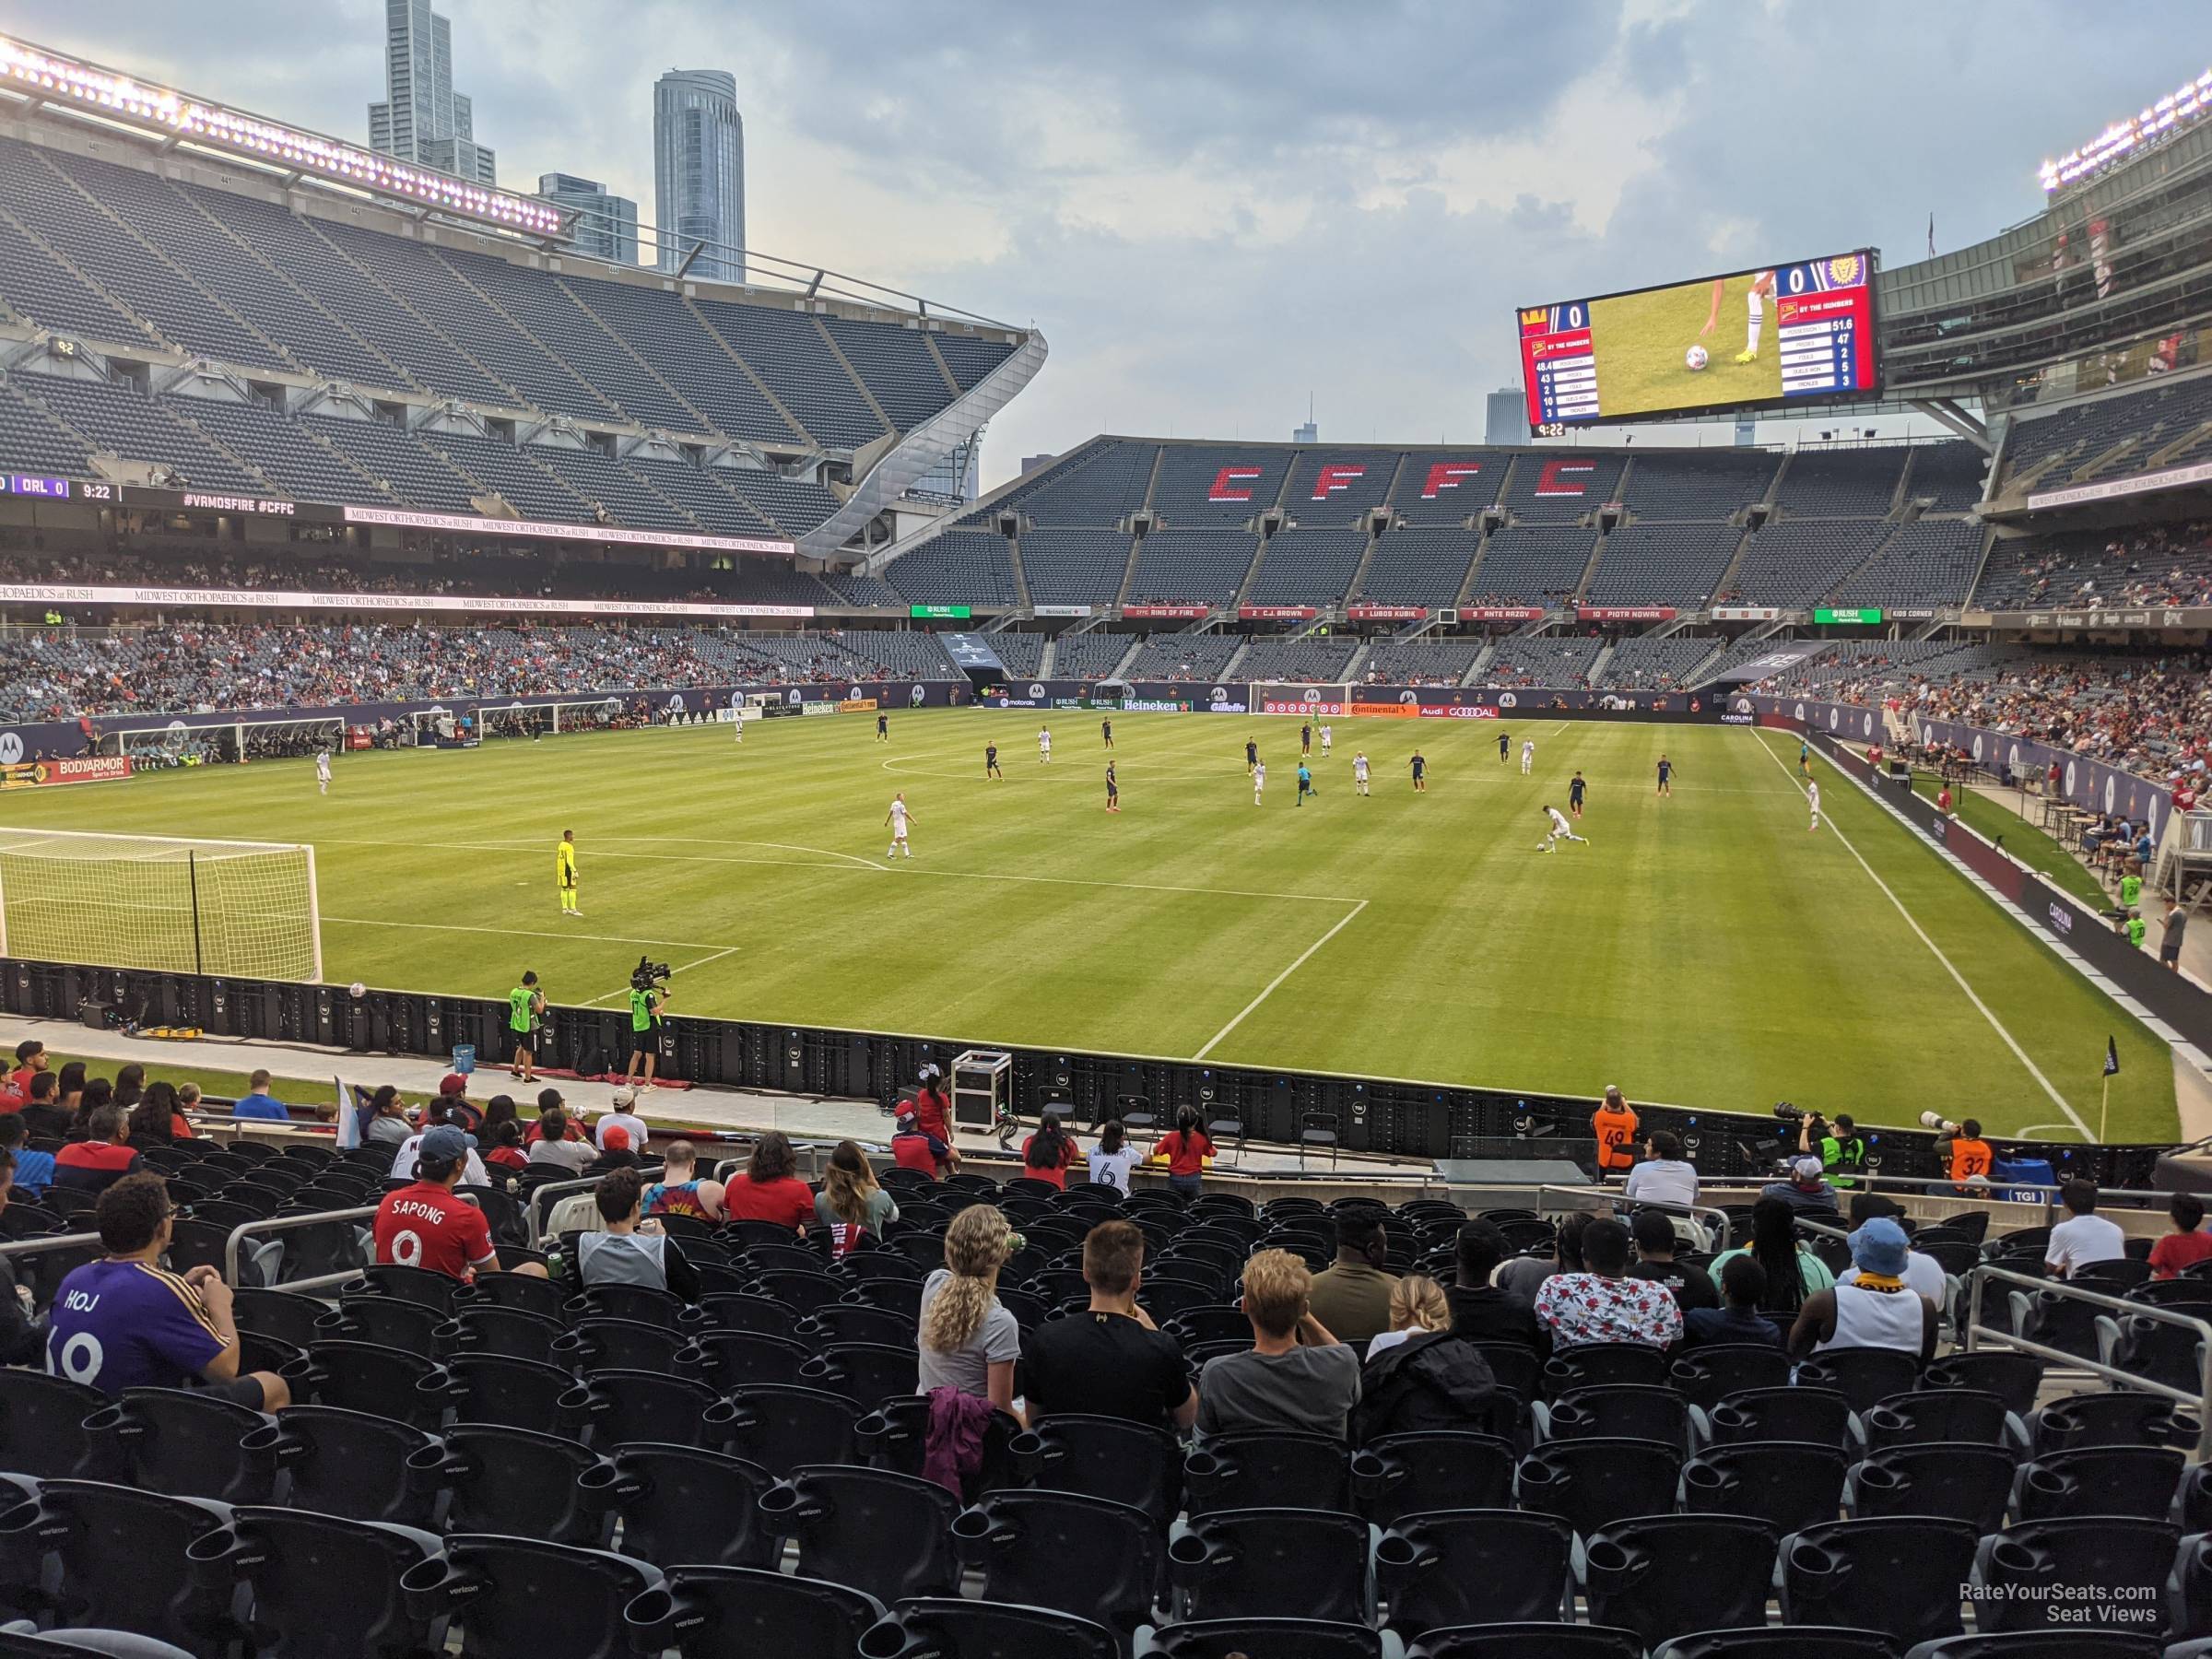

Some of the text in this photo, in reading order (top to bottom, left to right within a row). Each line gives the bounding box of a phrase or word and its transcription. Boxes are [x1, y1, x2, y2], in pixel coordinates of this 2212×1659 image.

[1790, 269, 1804, 293] 0
[1823, 299, 1853, 310] NUMBERS
[1570, 306, 1582, 328] 0
[1832, 318, 1853, 332] 51.6
[1566, 338, 1590, 347] NUMBERS
[1837, 333, 1849, 345] 47
[1841, 348, 1848, 359] 2
[1536, 361, 1552, 372] 48.4
[1841, 362, 1849, 372] 5
[1540, 374, 1550, 383] 43
[1842, 376, 1849, 386] 3
[1545, 386, 1550, 394] 2
[1544, 397, 1553, 406] 10
[1547, 409, 1552, 418] 3
[23, 478, 48, 493] ORL
[55, 482, 64, 495] 0
[84, 485, 111, 499] 9:22
[184, 493, 295, 515] #VAMOSFIRE #CFFC
[351, 510, 389, 522] MIDWEST
[390, 513, 446, 526] ORTHOPAEDICS
[453, 519, 472, 529] RUSH
[482, 520, 514, 532] MIDWEST
[572, 528, 589, 537] RUSH
[597, 530, 627, 540] MIDWEST
[677, 536, 693, 546] RUSH
[66, 589, 93, 600] RUSH
[135, 590, 178, 602] MIDWEST
[180, 591, 247, 603] ORTHOPAEDICS
[255, 594, 278, 605] RUSH
[312, 594, 350, 606] MIDWEST
[350, 596, 406, 607] ORTHOPAEDICS
[414, 598, 434, 608] RUSH
[463, 598, 496, 609] MIDWEST
[551, 602, 568, 610] RUSH
[594, 603, 622, 611] MIDWEST
[672, 605, 688, 613] RUSH
[1838, 609, 1858, 618] RUSH
[803, 703, 834, 715] Heineken
[1124, 700, 1178, 712] Heineken
[1210, 702, 1246, 712] Gillette
[1351, 704, 1399, 714] Continental
[1421, 707, 1443, 715] Audi
[60, 758, 124, 774] BODYARMOR
[2049, 901, 2072, 929] CAROLINA
[1605, 1131, 1625, 1147] 49
[1963, 1158, 1984, 1175] 32
[1098, 1161, 1115, 1185] 6
[2015, 1192, 2035, 1202] TGI
[392, 1200, 446, 1225] SAPONG
[392, 1230, 421, 1267] 9
[64, 1289, 100, 1312] HOJ
[445, 1465, 469, 1474] verizon
[617, 1485, 640, 1494] verizon
[798, 1508, 821, 1516] verizon
[39, 1525, 68, 1536] verizon
[236, 1555, 265, 1565] verizon
[449, 1584, 478, 1595] verizon
[676, 1616, 704, 1629] verizon
